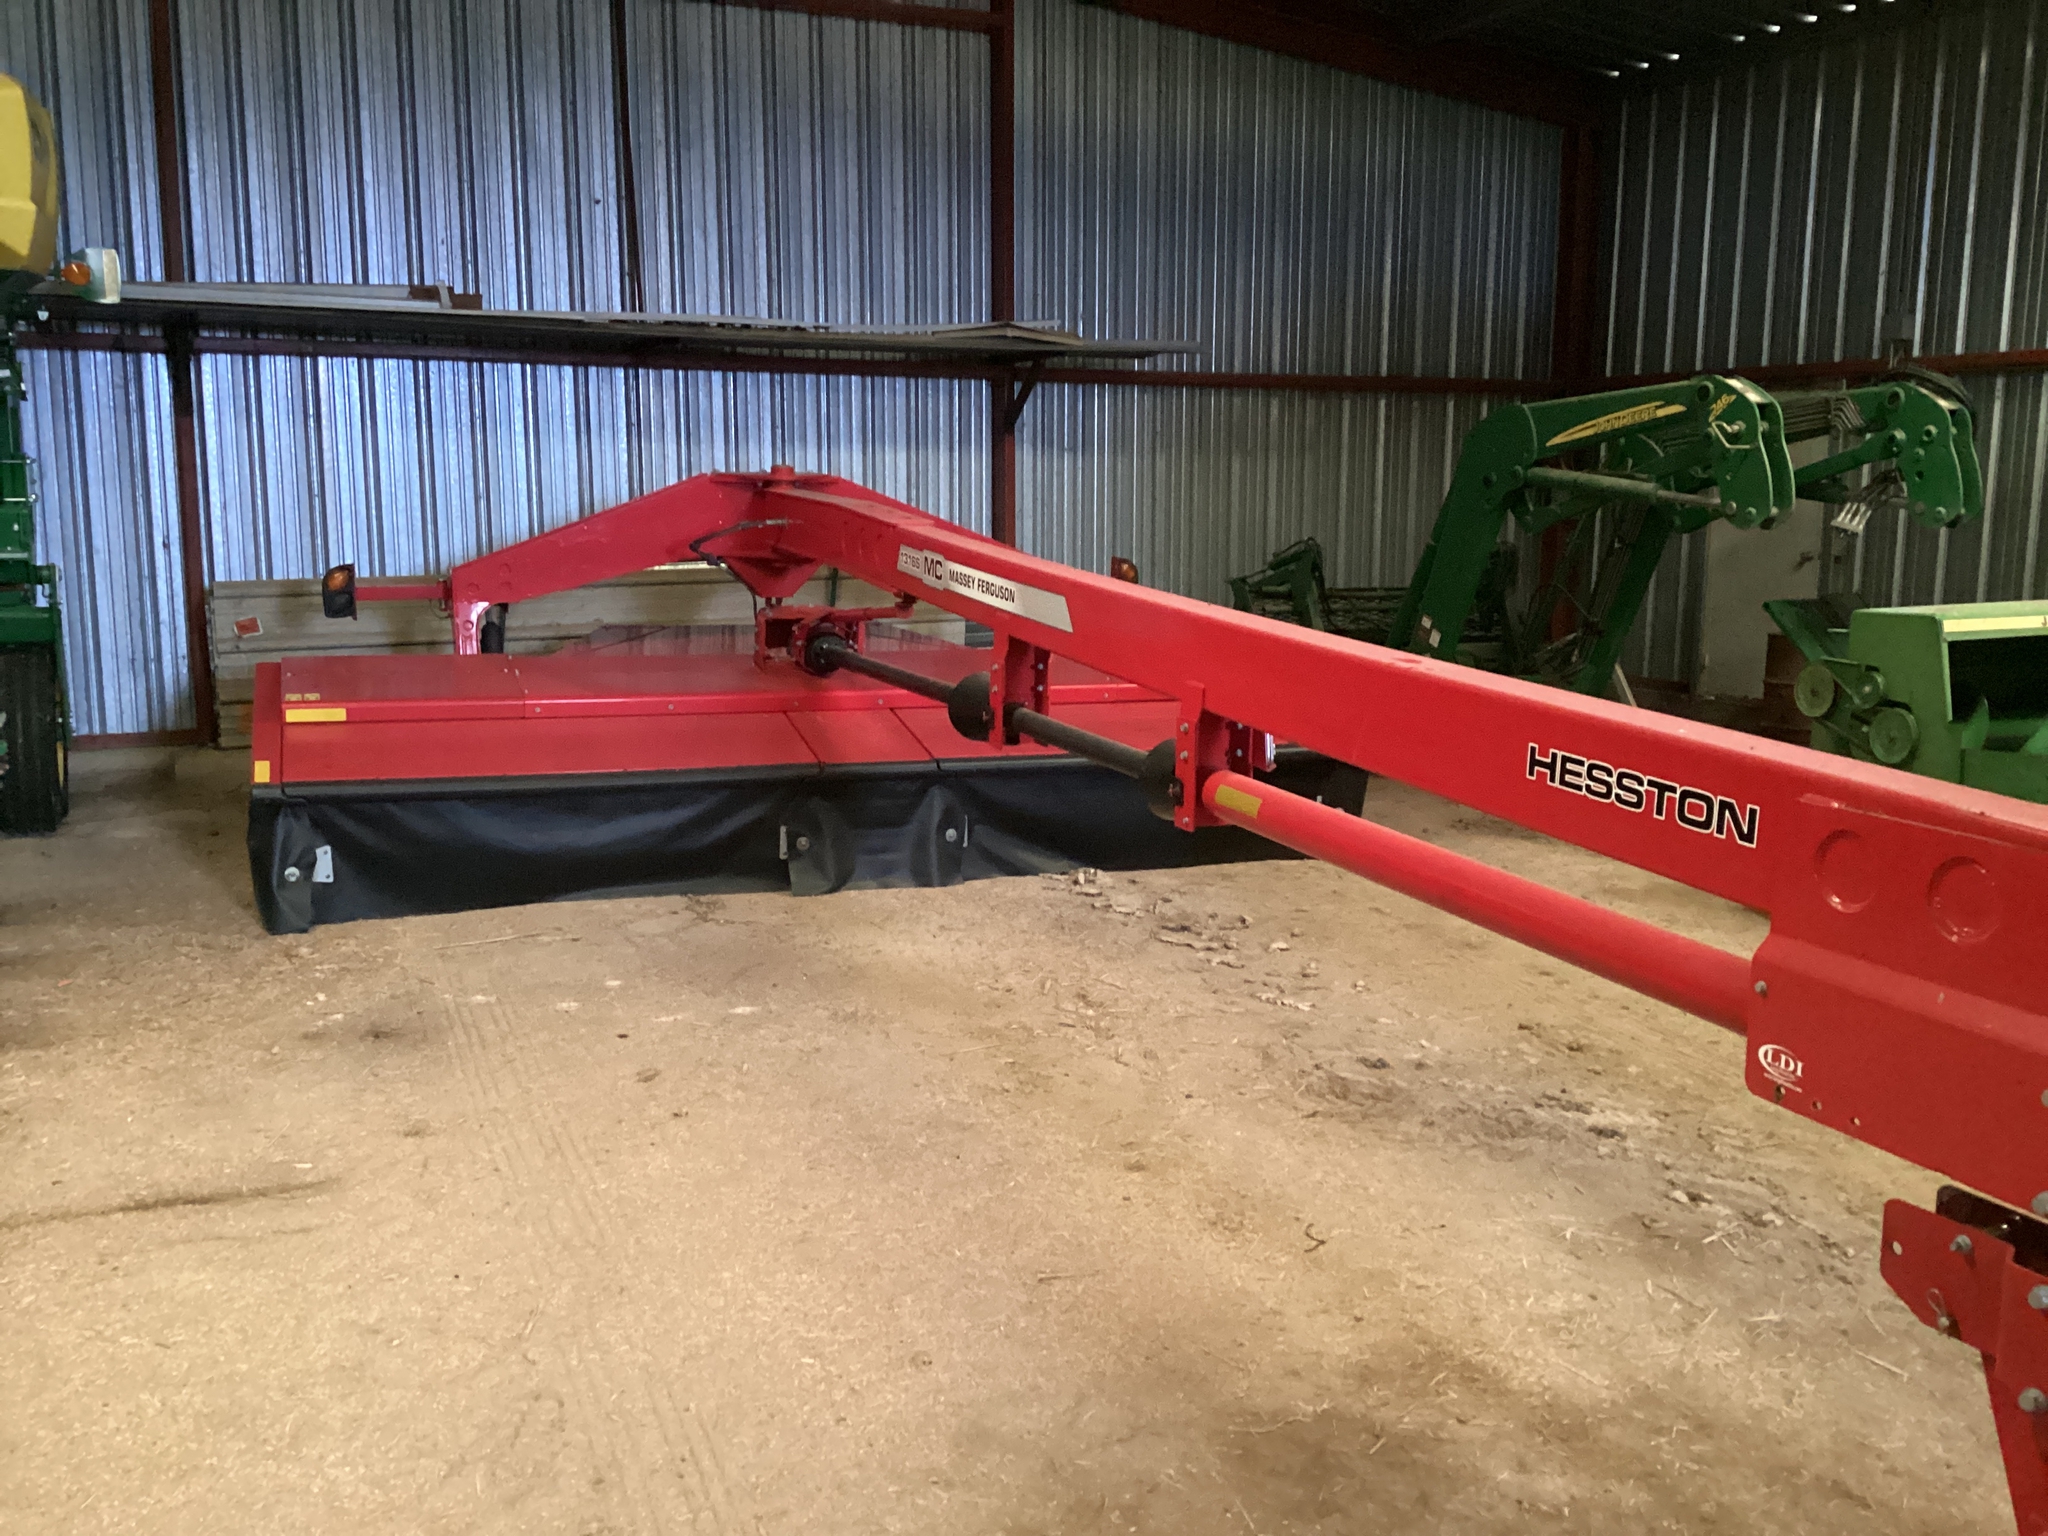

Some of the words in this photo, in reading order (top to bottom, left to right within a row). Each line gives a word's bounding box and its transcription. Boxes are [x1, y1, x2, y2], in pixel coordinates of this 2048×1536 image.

[923, 556, 943, 580] MC
[948, 568, 976, 590] MASSEY
[977, 578, 1016, 604] FERGUSON
[1526, 742, 1760, 849] HESSTON
[1765, 1047, 1804, 1078] LDI
